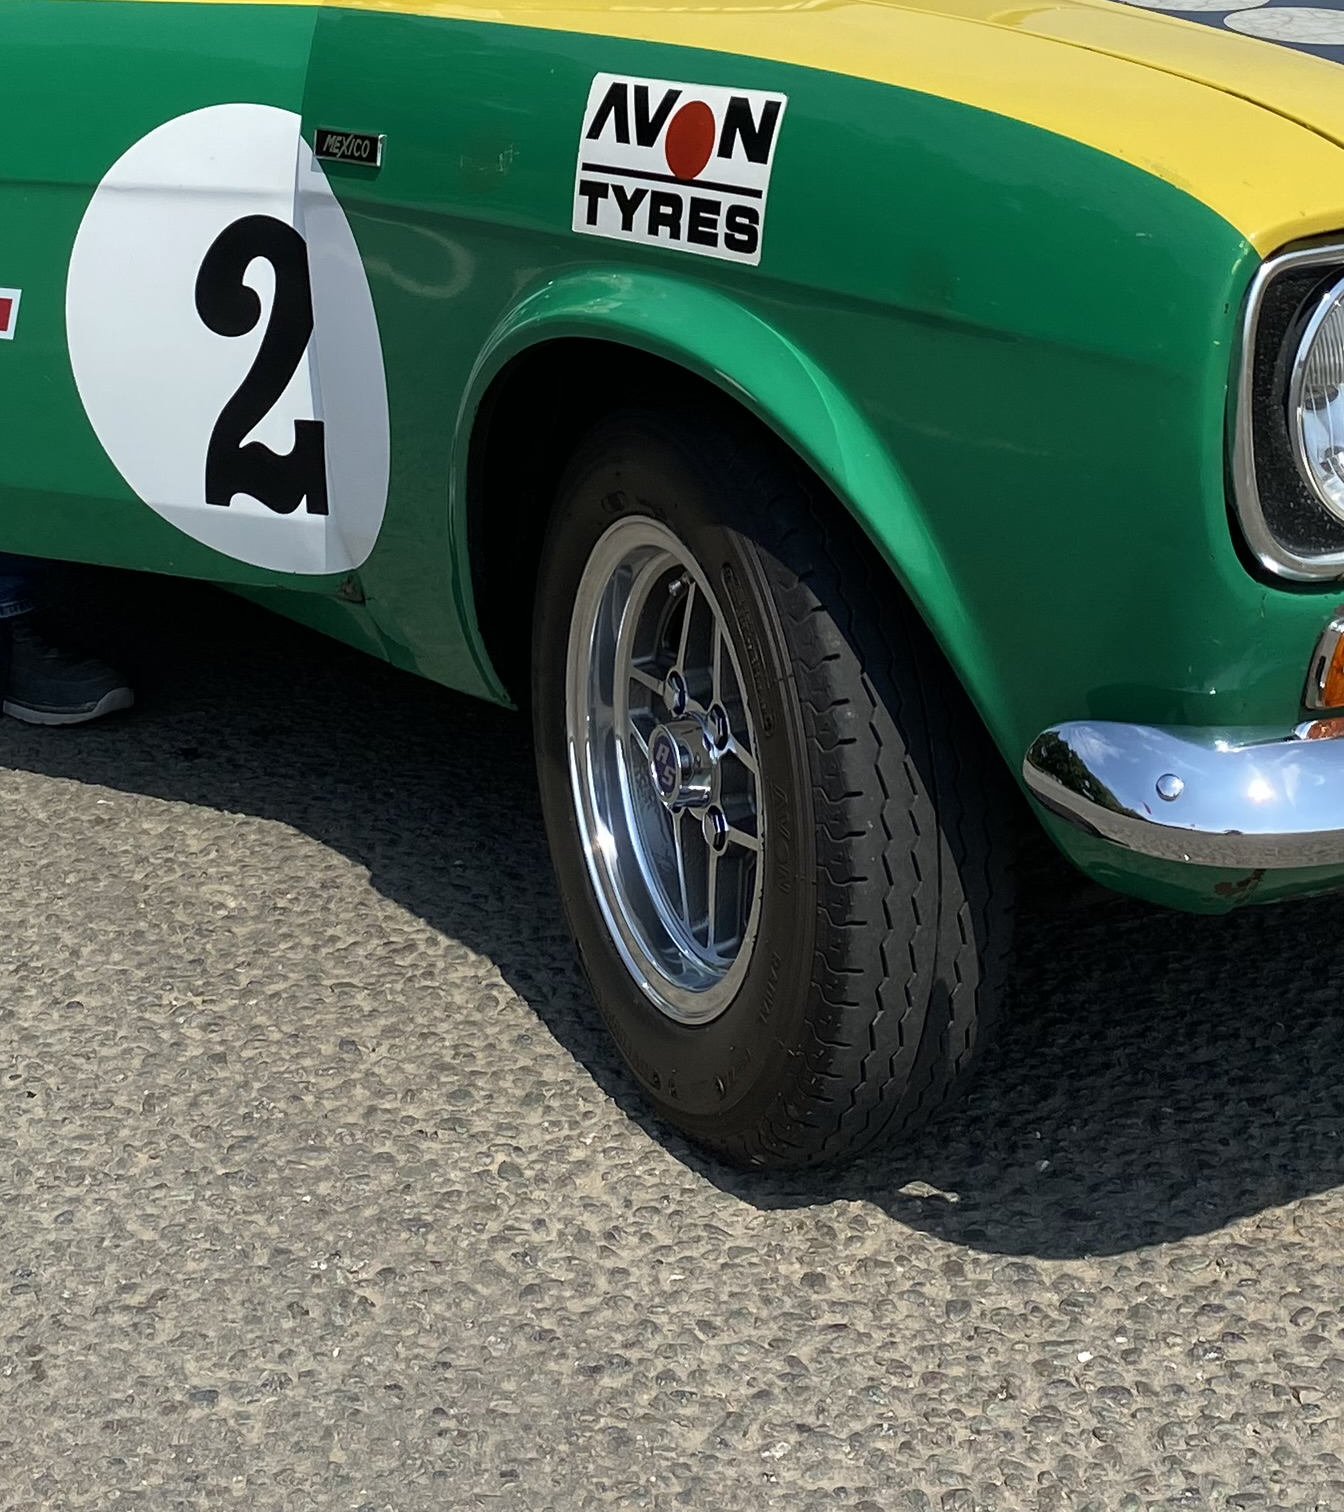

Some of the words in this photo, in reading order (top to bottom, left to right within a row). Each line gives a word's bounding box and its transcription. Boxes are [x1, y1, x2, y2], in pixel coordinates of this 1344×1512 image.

[322, 133, 371, 159] MEXICO
[585, 81, 782, 181] AVON
[578, 178, 761, 255] TYRES
[194, 213, 329, 516] 2
